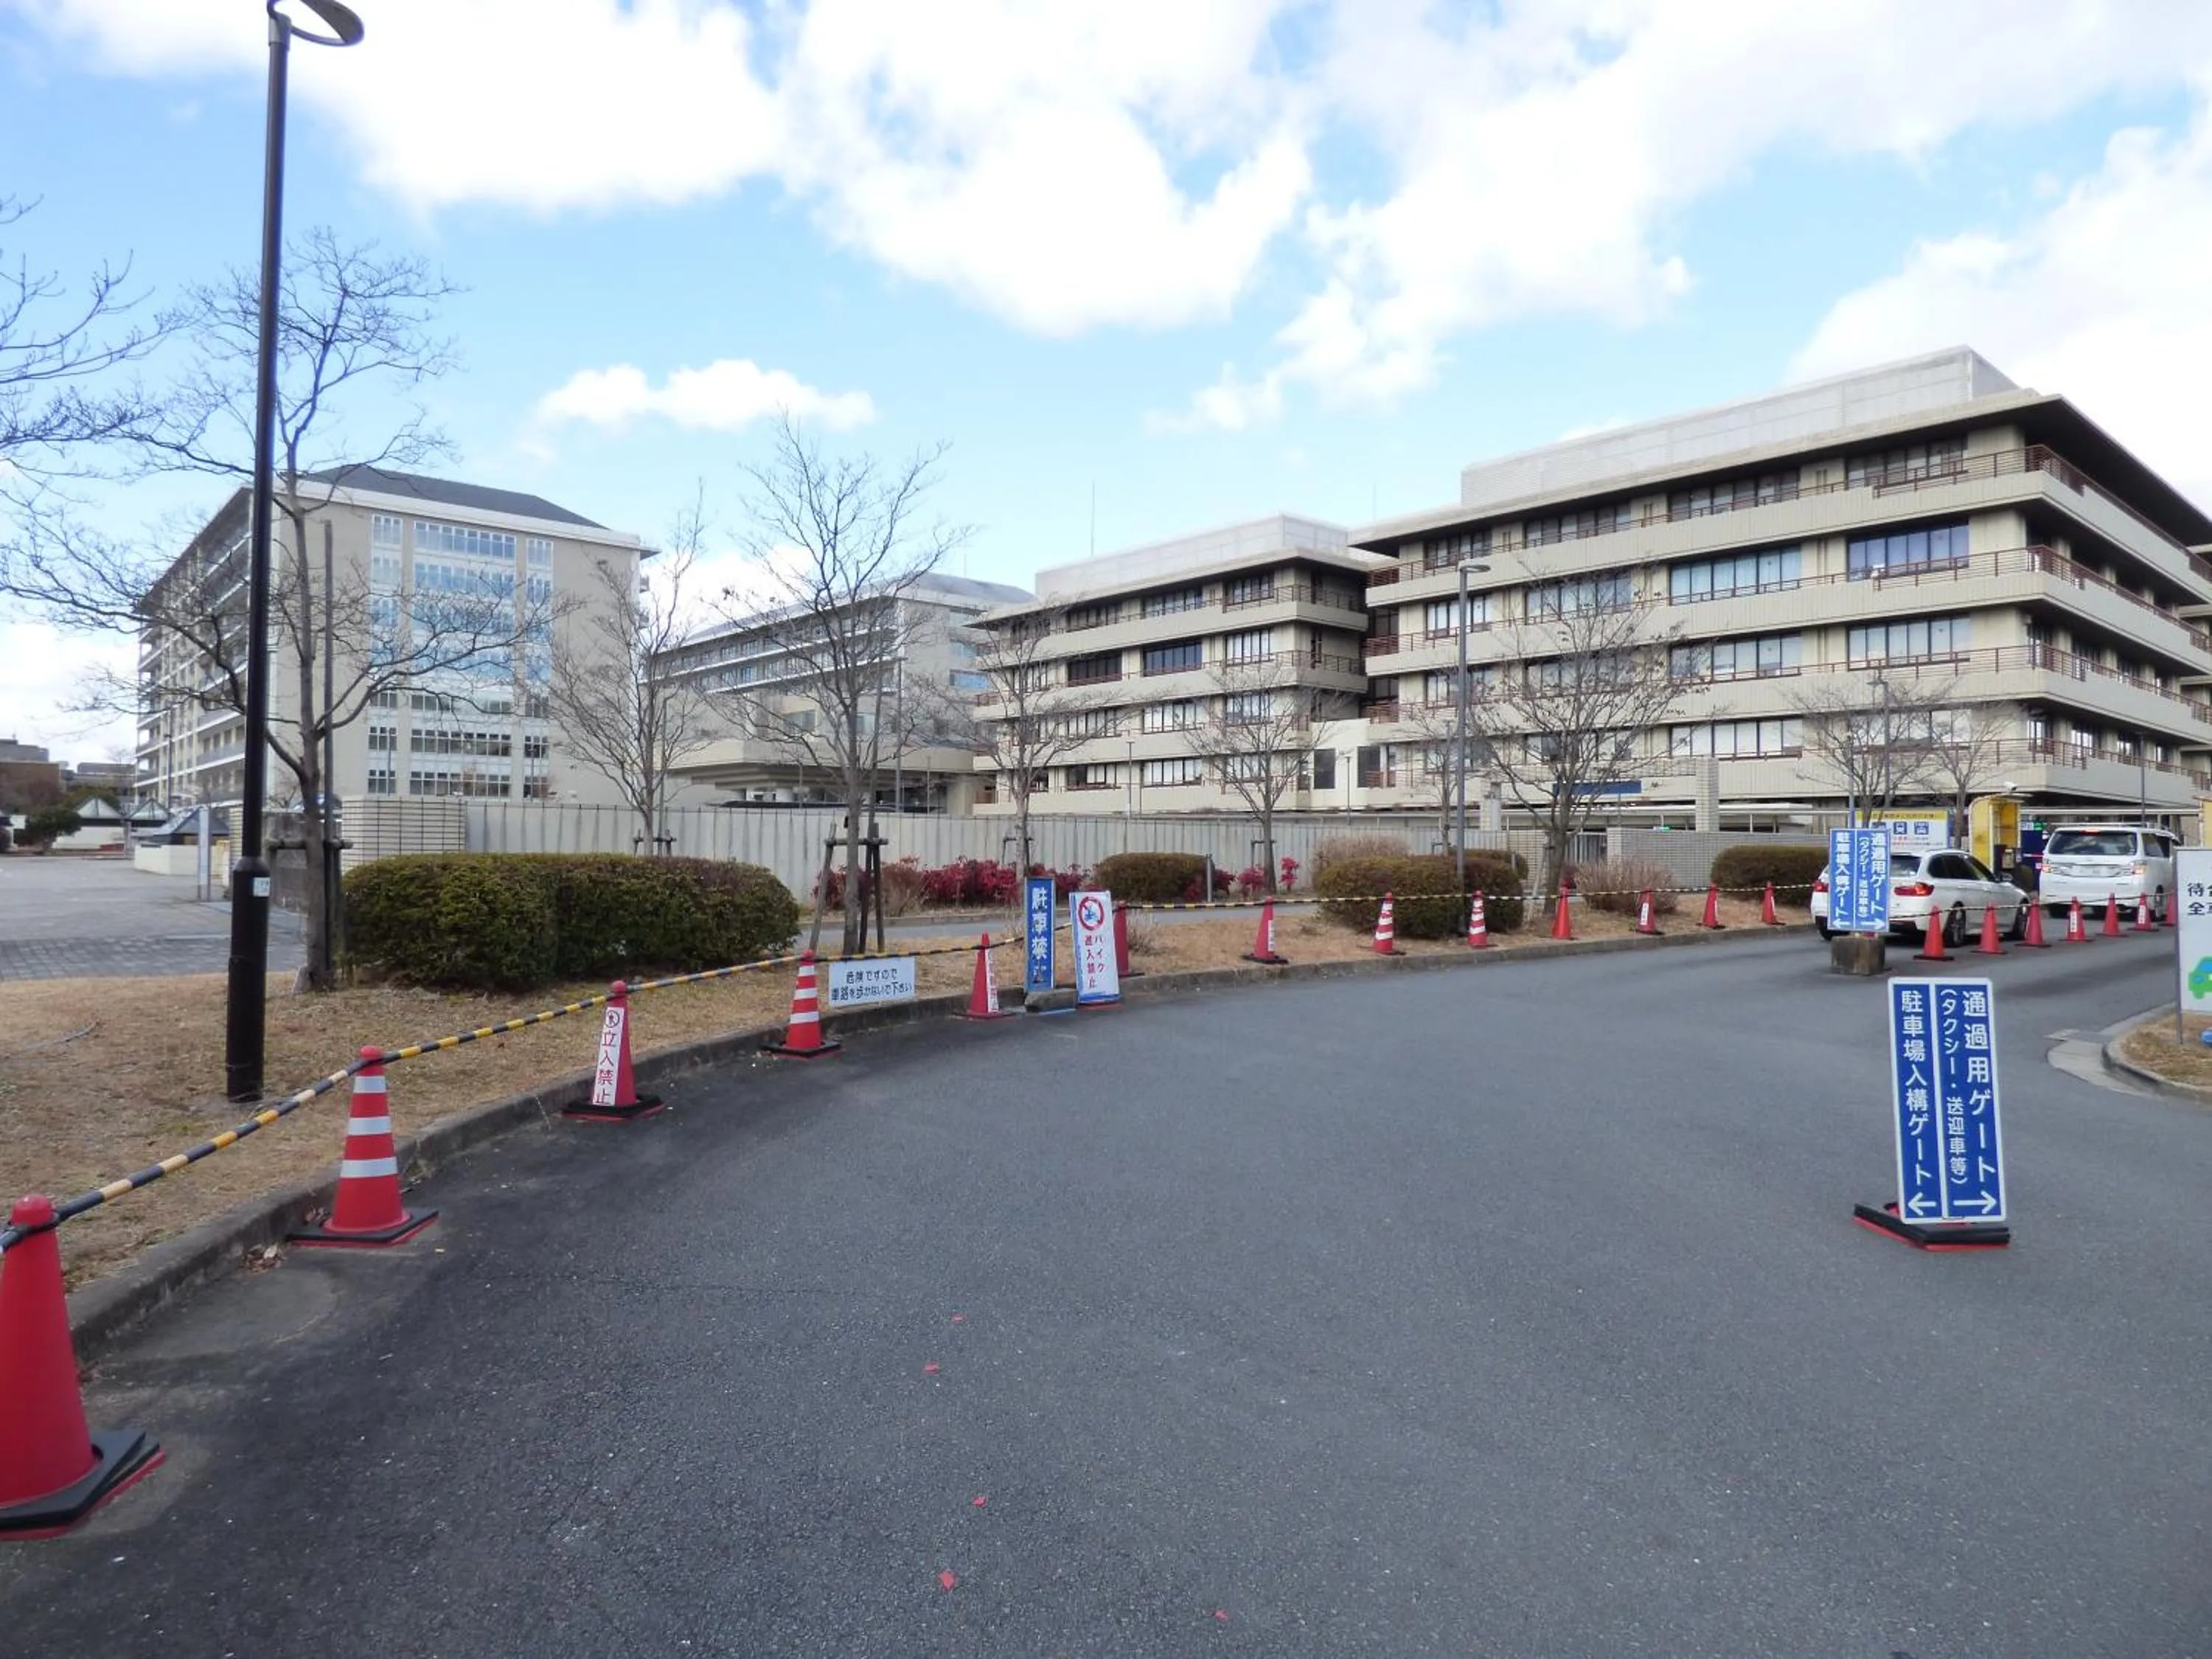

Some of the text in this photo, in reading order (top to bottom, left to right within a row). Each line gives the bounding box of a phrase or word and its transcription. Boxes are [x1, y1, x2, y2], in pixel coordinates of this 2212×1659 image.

[595, 1030, 617, 1105] 立入禁止
[1901, 990, 1933, 1186] 駐車場入構ゲート
[1962, 990, 1997, 1183] 通過用ゲート
